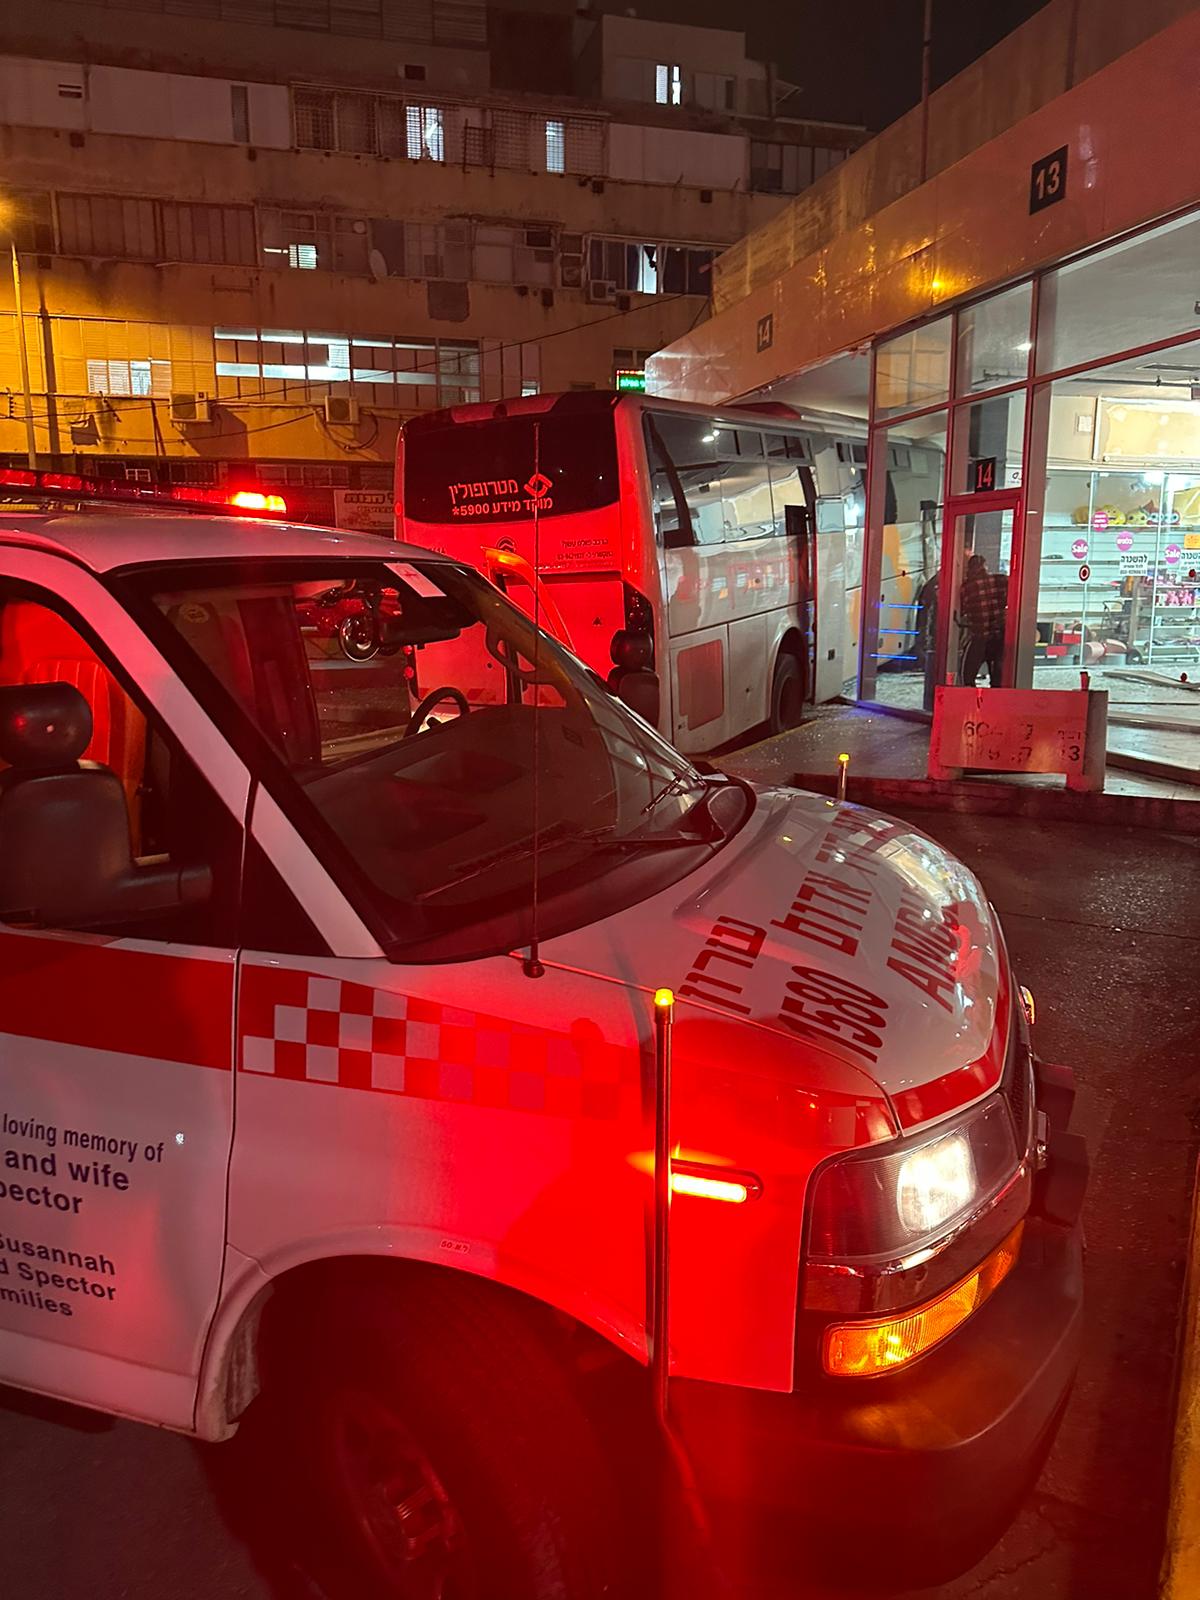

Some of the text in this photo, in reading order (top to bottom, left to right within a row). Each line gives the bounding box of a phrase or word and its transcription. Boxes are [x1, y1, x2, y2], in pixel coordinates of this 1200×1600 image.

[1035, 160, 1060, 200] 13
[759, 319, 770, 347] 14
[976, 462, 992, 489] 14
[448, 479, 519, 504] מטרופולין
[492, 500, 521, 513] מידע
[523, 497, 553, 512] מוקד
[1071, 544, 1088, 553] Sale
[1165, 549, 1181, 558] Sale
[769, 870, 873, 957] אדום
[678, 915, 768, 1015] שרון
[777, 965, 889, 1063] 1580
[3, 1113, 164, 1163] loving memory of
[5, 1150, 130, 1190] and wife
[17, 1261, 116, 1301] Spector
[0, 1286, 73, 1316] milies
